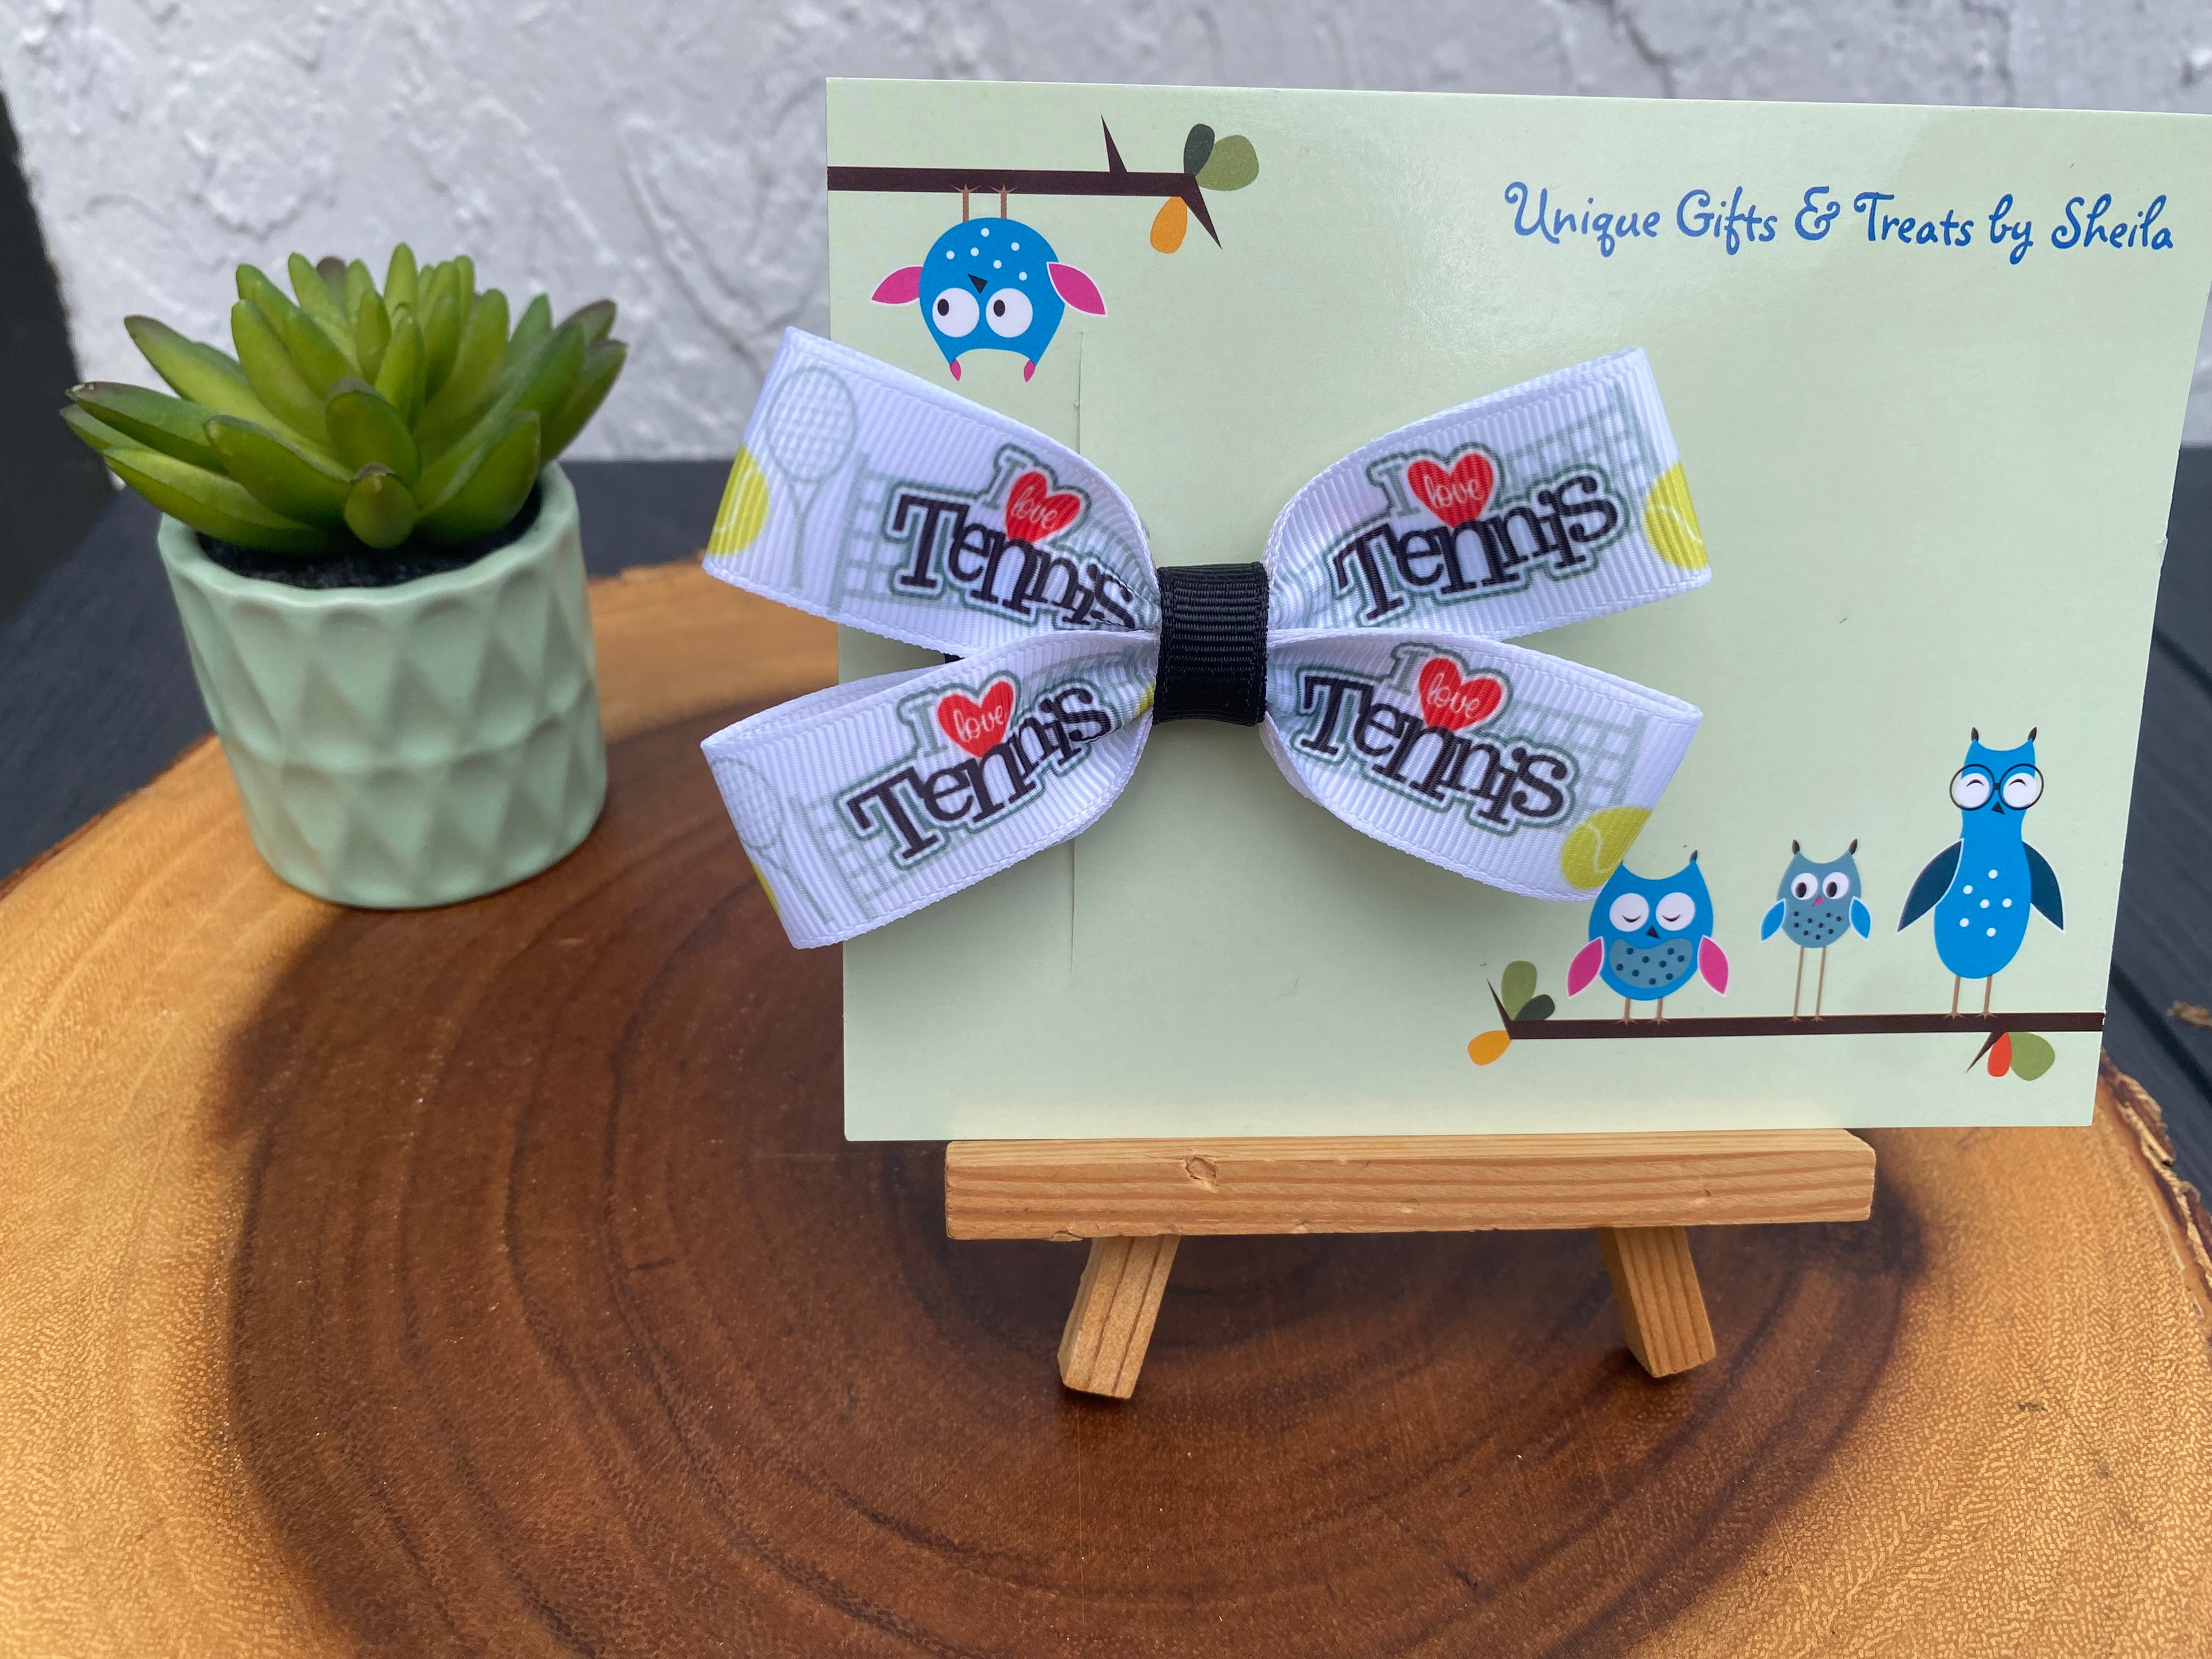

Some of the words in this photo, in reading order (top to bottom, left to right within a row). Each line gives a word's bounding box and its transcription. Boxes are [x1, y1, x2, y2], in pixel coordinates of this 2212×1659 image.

[1504, 181, 1660, 257] Unique
[1676, 185, 1776, 256] Gifts
[1794, 185, 1840, 242] &
[1853, 191, 1972, 247] Treats
[1987, 193, 2033, 266] by
[2051, 192, 2173, 252] Sheila
[1011, 487, 1058, 531] love
[1423, 474, 1484, 509] love
[1332, 475, 1618, 622] Tennis
[952, 705, 1006, 744] love
[1426, 673, 1480, 719] love
[846, 688, 1112, 859] Tennis
[1300, 675, 1568, 825] Tennis
